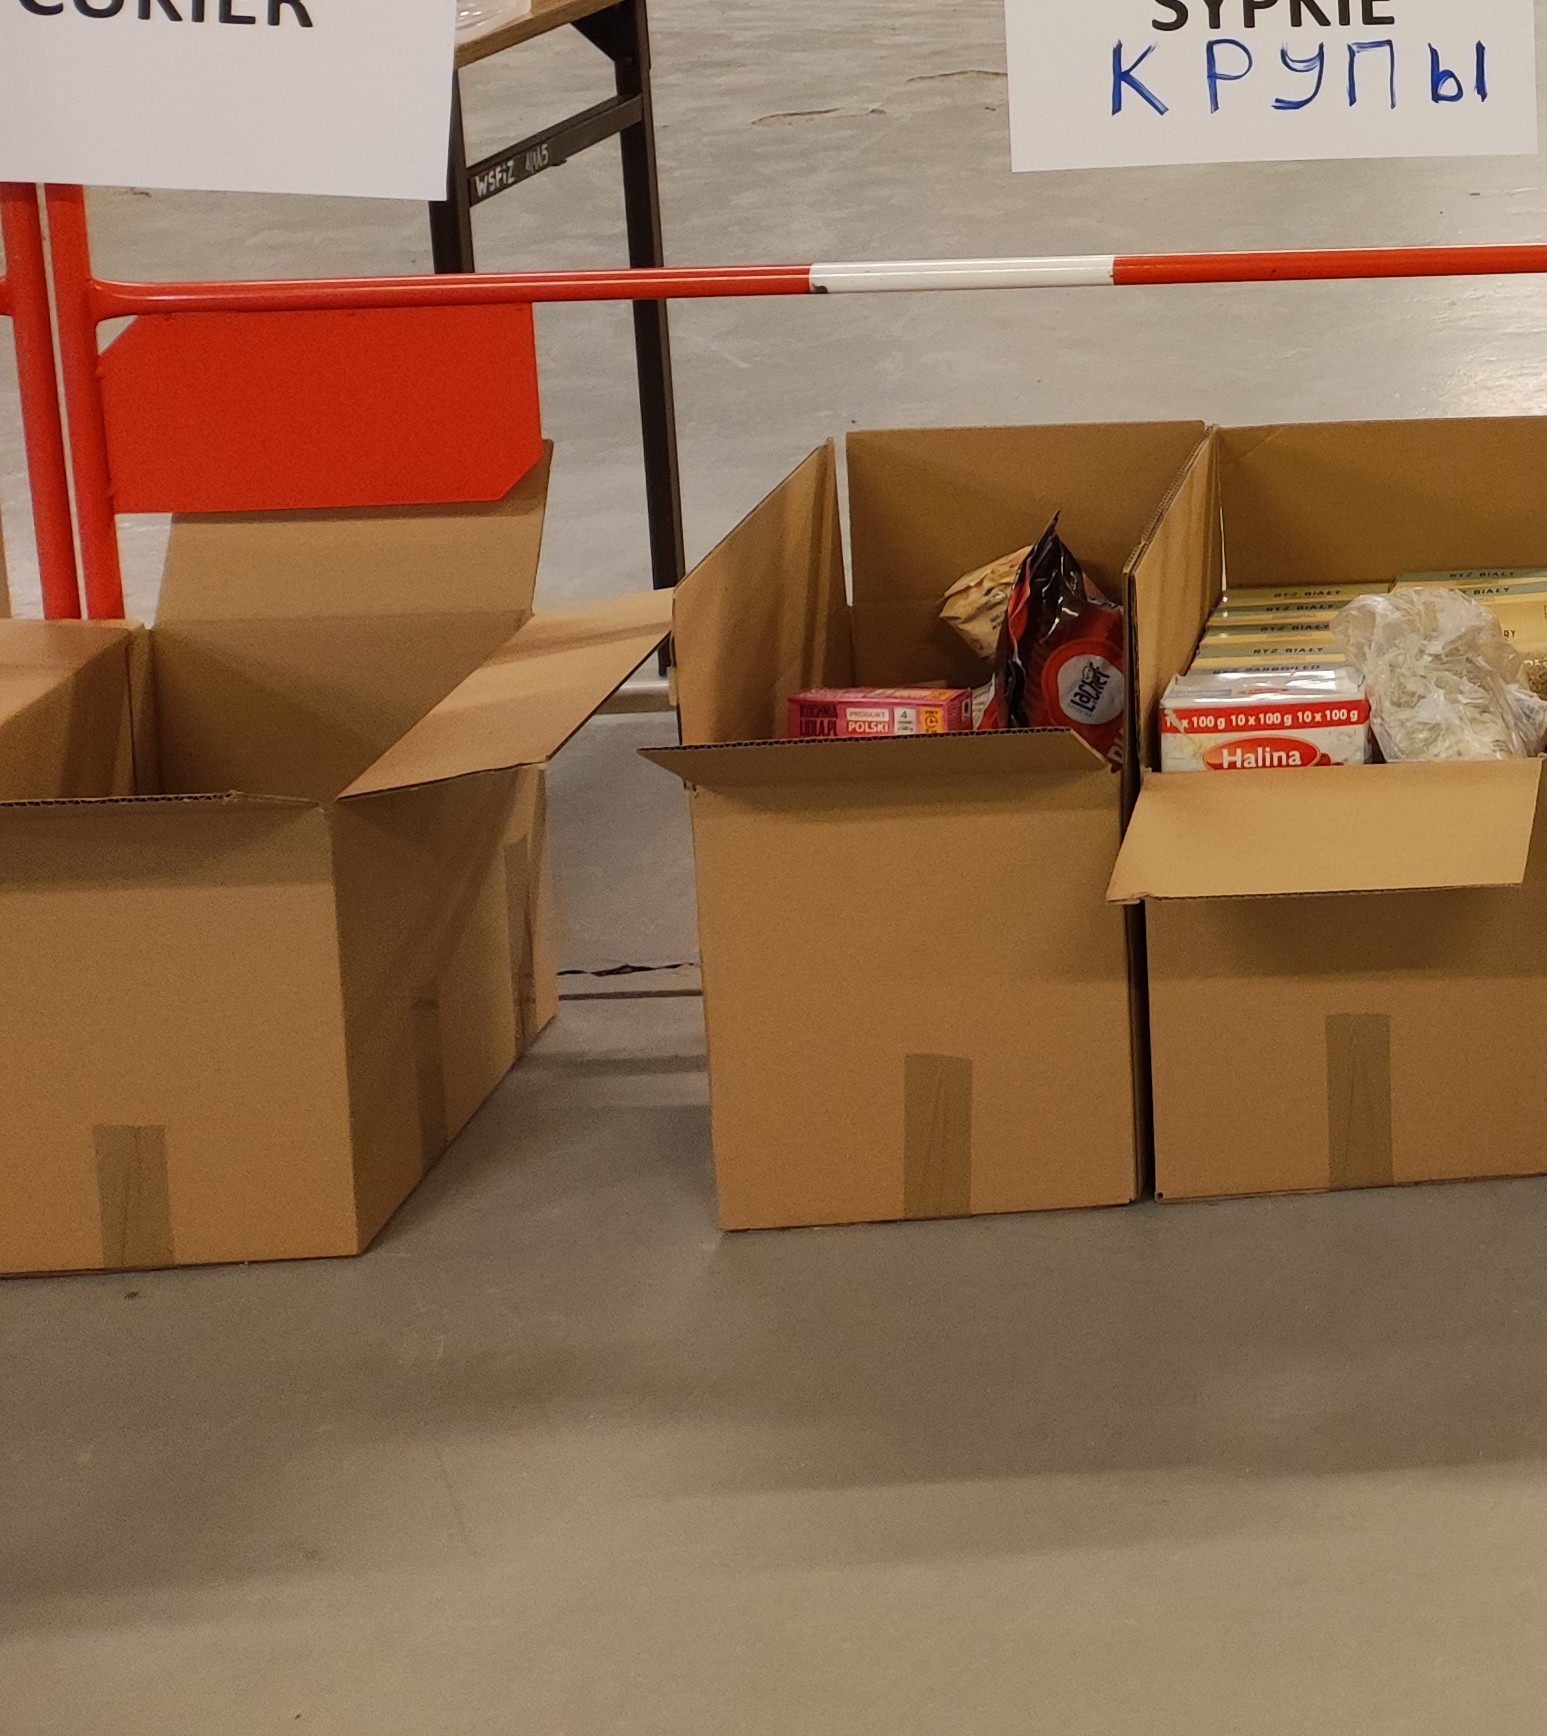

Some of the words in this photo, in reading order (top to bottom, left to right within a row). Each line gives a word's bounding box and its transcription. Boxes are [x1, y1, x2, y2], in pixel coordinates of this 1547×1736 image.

[1111, 38, 1488, 116] КРУПЫ
[900, 710, 908, 720] 4
[1191, 716, 1215, 728] 100
[1217, 717, 1226, 730] g
[1230, 714, 1246, 726] 10
[1247, 716, 1256, 725] x
[1259, 713, 1282, 725] 100
[1284, 714, 1292, 727] g
[1297, 711, 1312, 723] 10
[1314, 713, 1322, 722] x
[1325, 709, 1348, 721] 100
[1350, 710, 1359, 723] g
[848, 721, 889, 733] POLSKI
[1220, 746, 1302, 769] Halina
